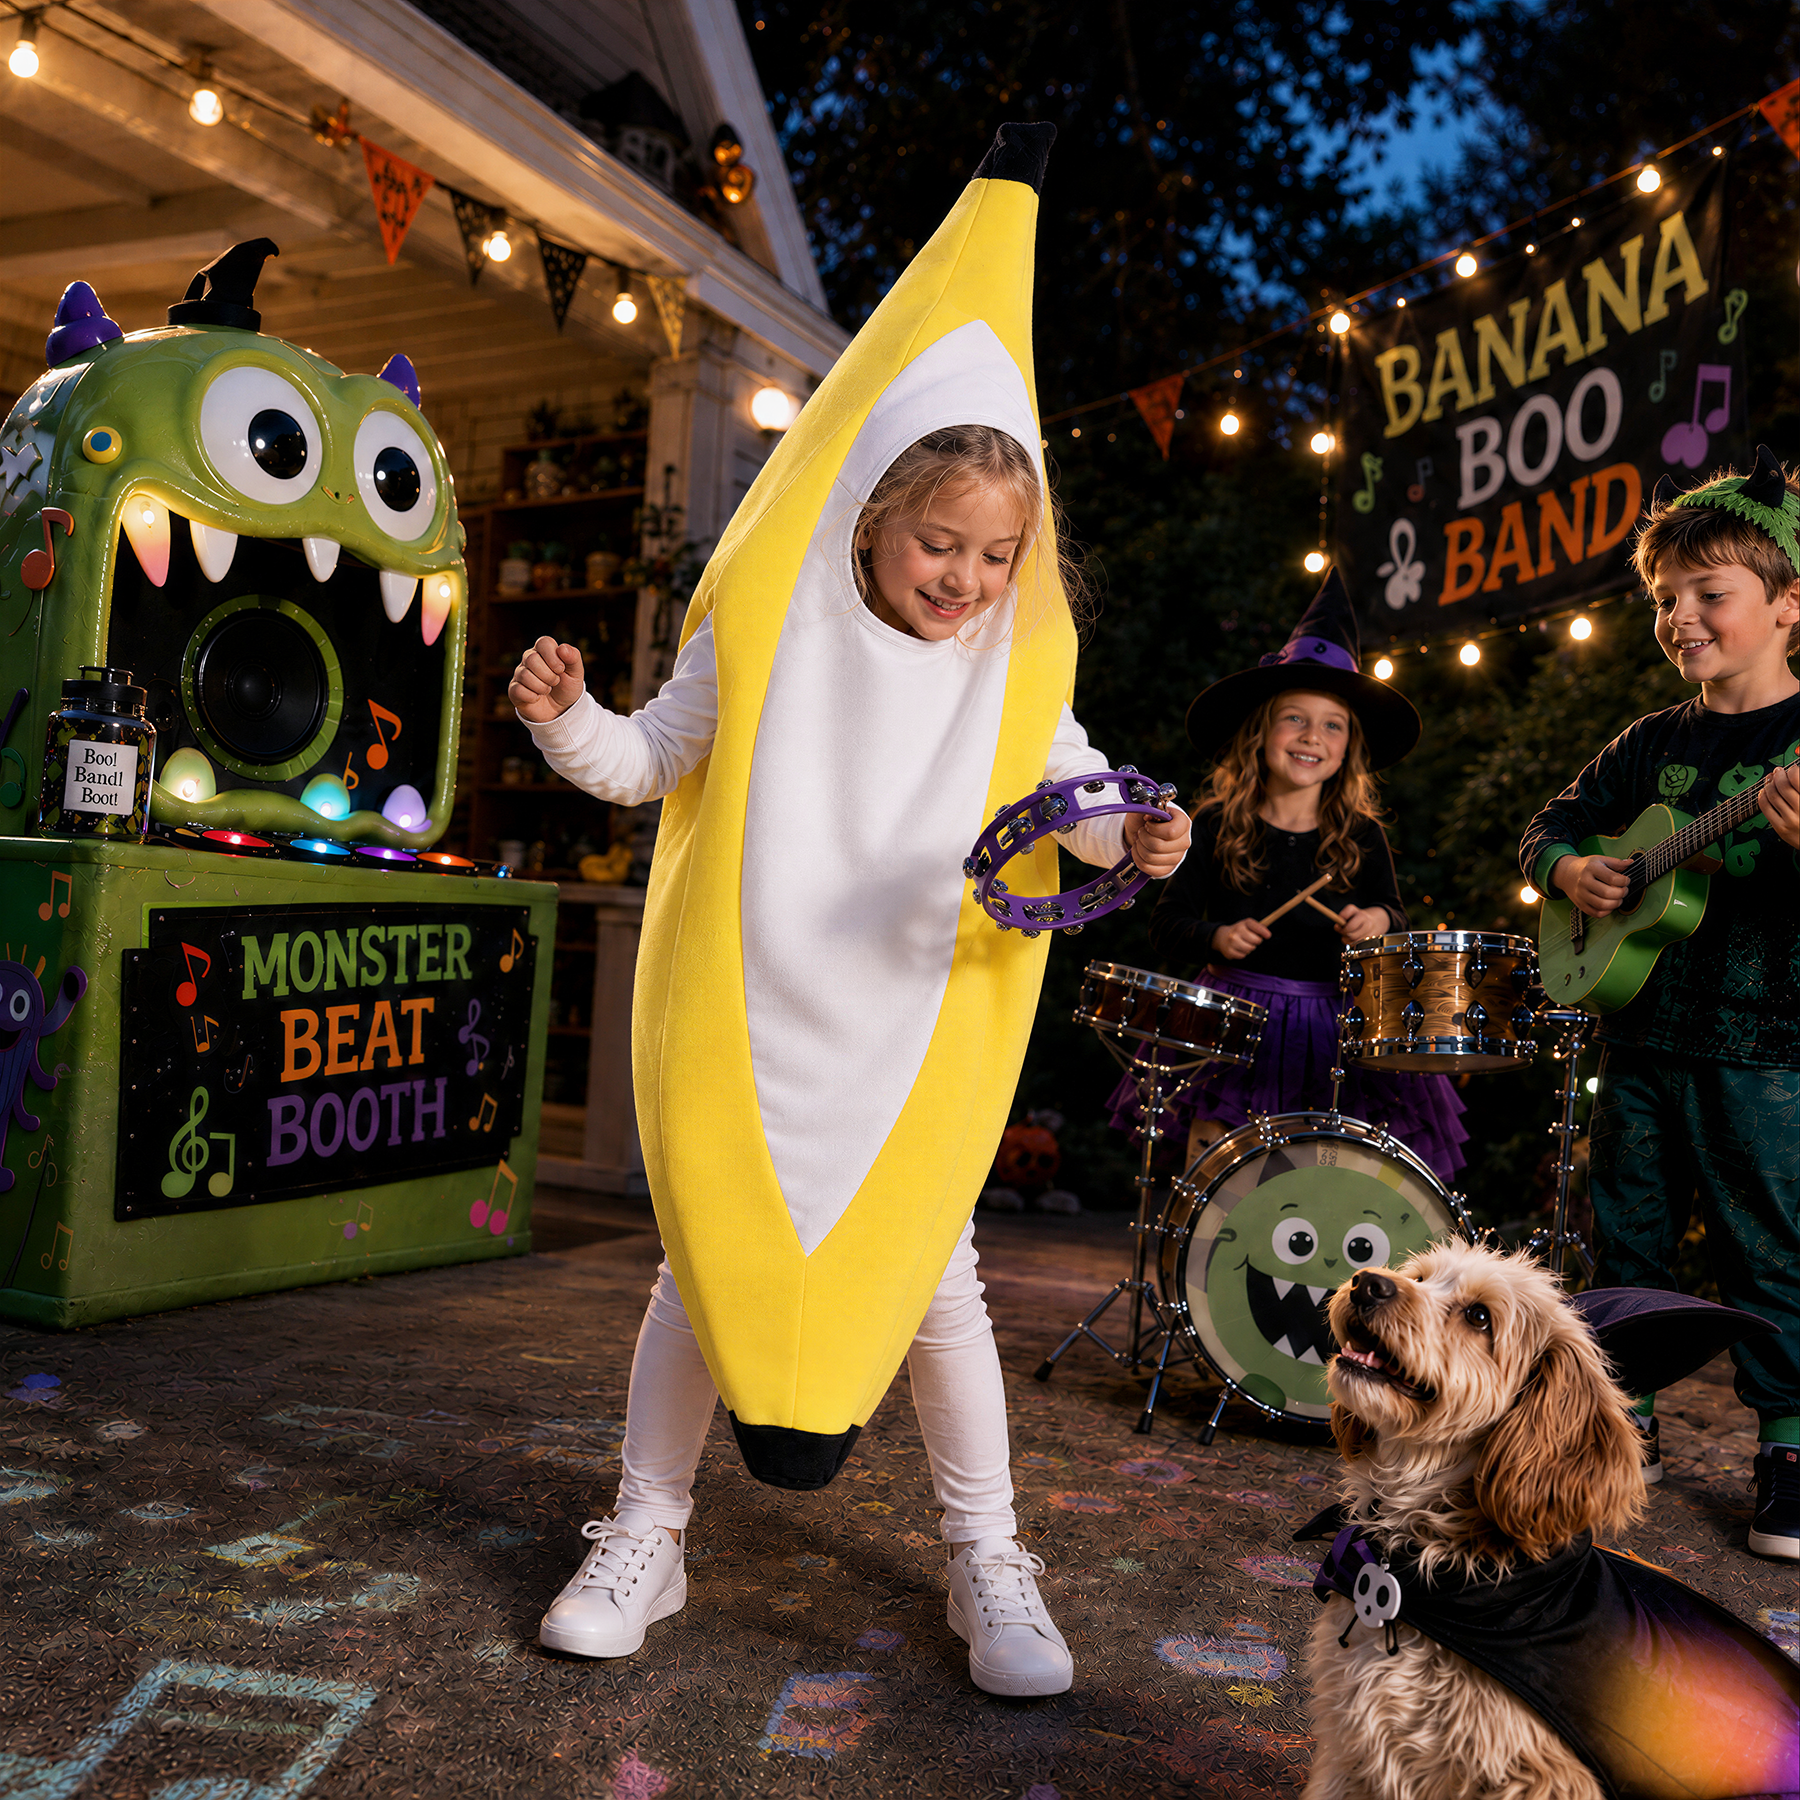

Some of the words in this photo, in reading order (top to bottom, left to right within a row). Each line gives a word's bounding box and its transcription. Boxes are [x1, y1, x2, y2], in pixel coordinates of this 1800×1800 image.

[1374, 209, 1709, 439] BANANA
[1456, 366, 1623, 510] BOO
[1438, 461, 1643, 606] BAND
[241, 923, 473, 1000] MONSTER
[280, 997, 435, 1083] BEAT
[266, 1076, 448, 1167] BOOTH
